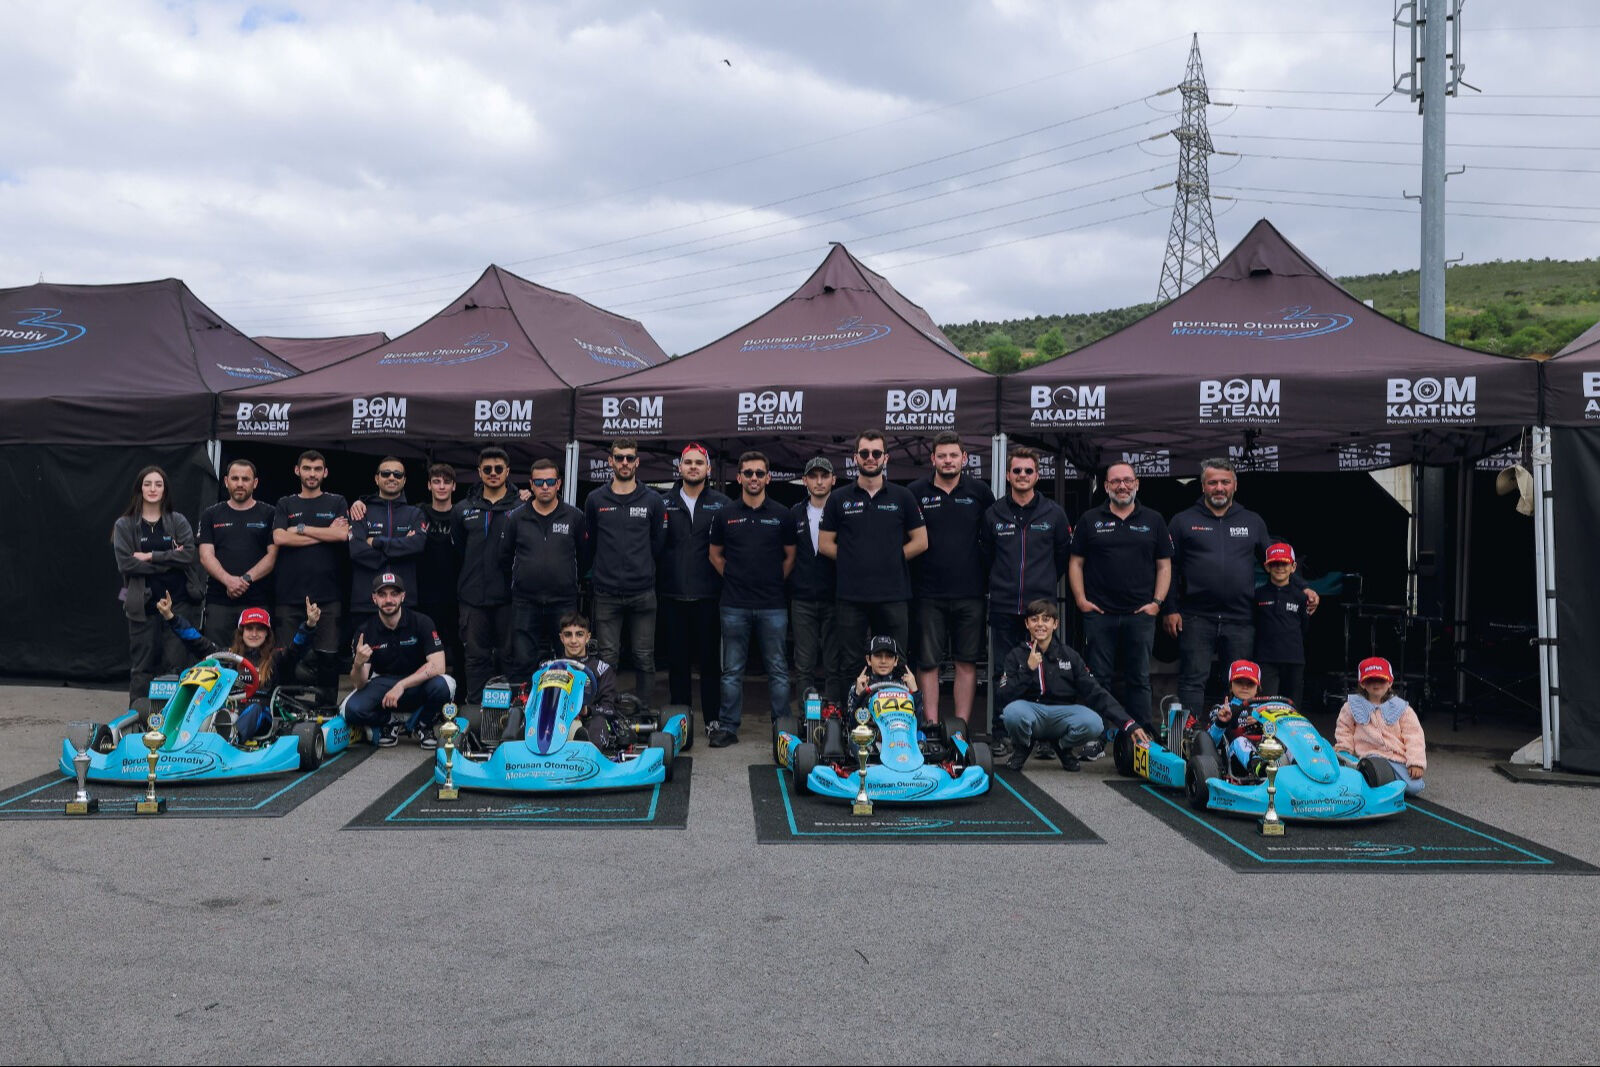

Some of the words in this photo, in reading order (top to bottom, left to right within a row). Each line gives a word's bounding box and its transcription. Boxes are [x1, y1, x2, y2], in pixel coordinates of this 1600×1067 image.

[1171, 328, 1264, 337] Motorsport
[1173, 321, 1238, 329] Borusan
[1244, 321, 1319, 329] Otomotiv
[744, 336, 797, 345] Borusan
[802, 331, 863, 341] Otomotiv
[1030, 385, 1105, 408] BOM
[1199, 378, 1280, 404] BOM
[1387, 376, 1476, 403] BOM
[352, 397, 406, 418] BOM
[602, 396, 664, 419] BOM
[737, 391, 803, 413] BOM
[886, 388, 957, 412] BOM
[236, 402, 291, 420] BOM
[475, 399, 533, 420] BOM
[1199, 404, 1279, 417] E-TEAM
[351, 417, 405, 429] E-TEAM
[737, 413, 801, 425] E-TEAM
[485, 691, 509, 699] BOM
[873, 698, 915, 713] 144
[161, 756, 204, 765] Otomotiv
[505, 762, 541, 771] Borusan
[1135, 746, 1148, 777] 54
